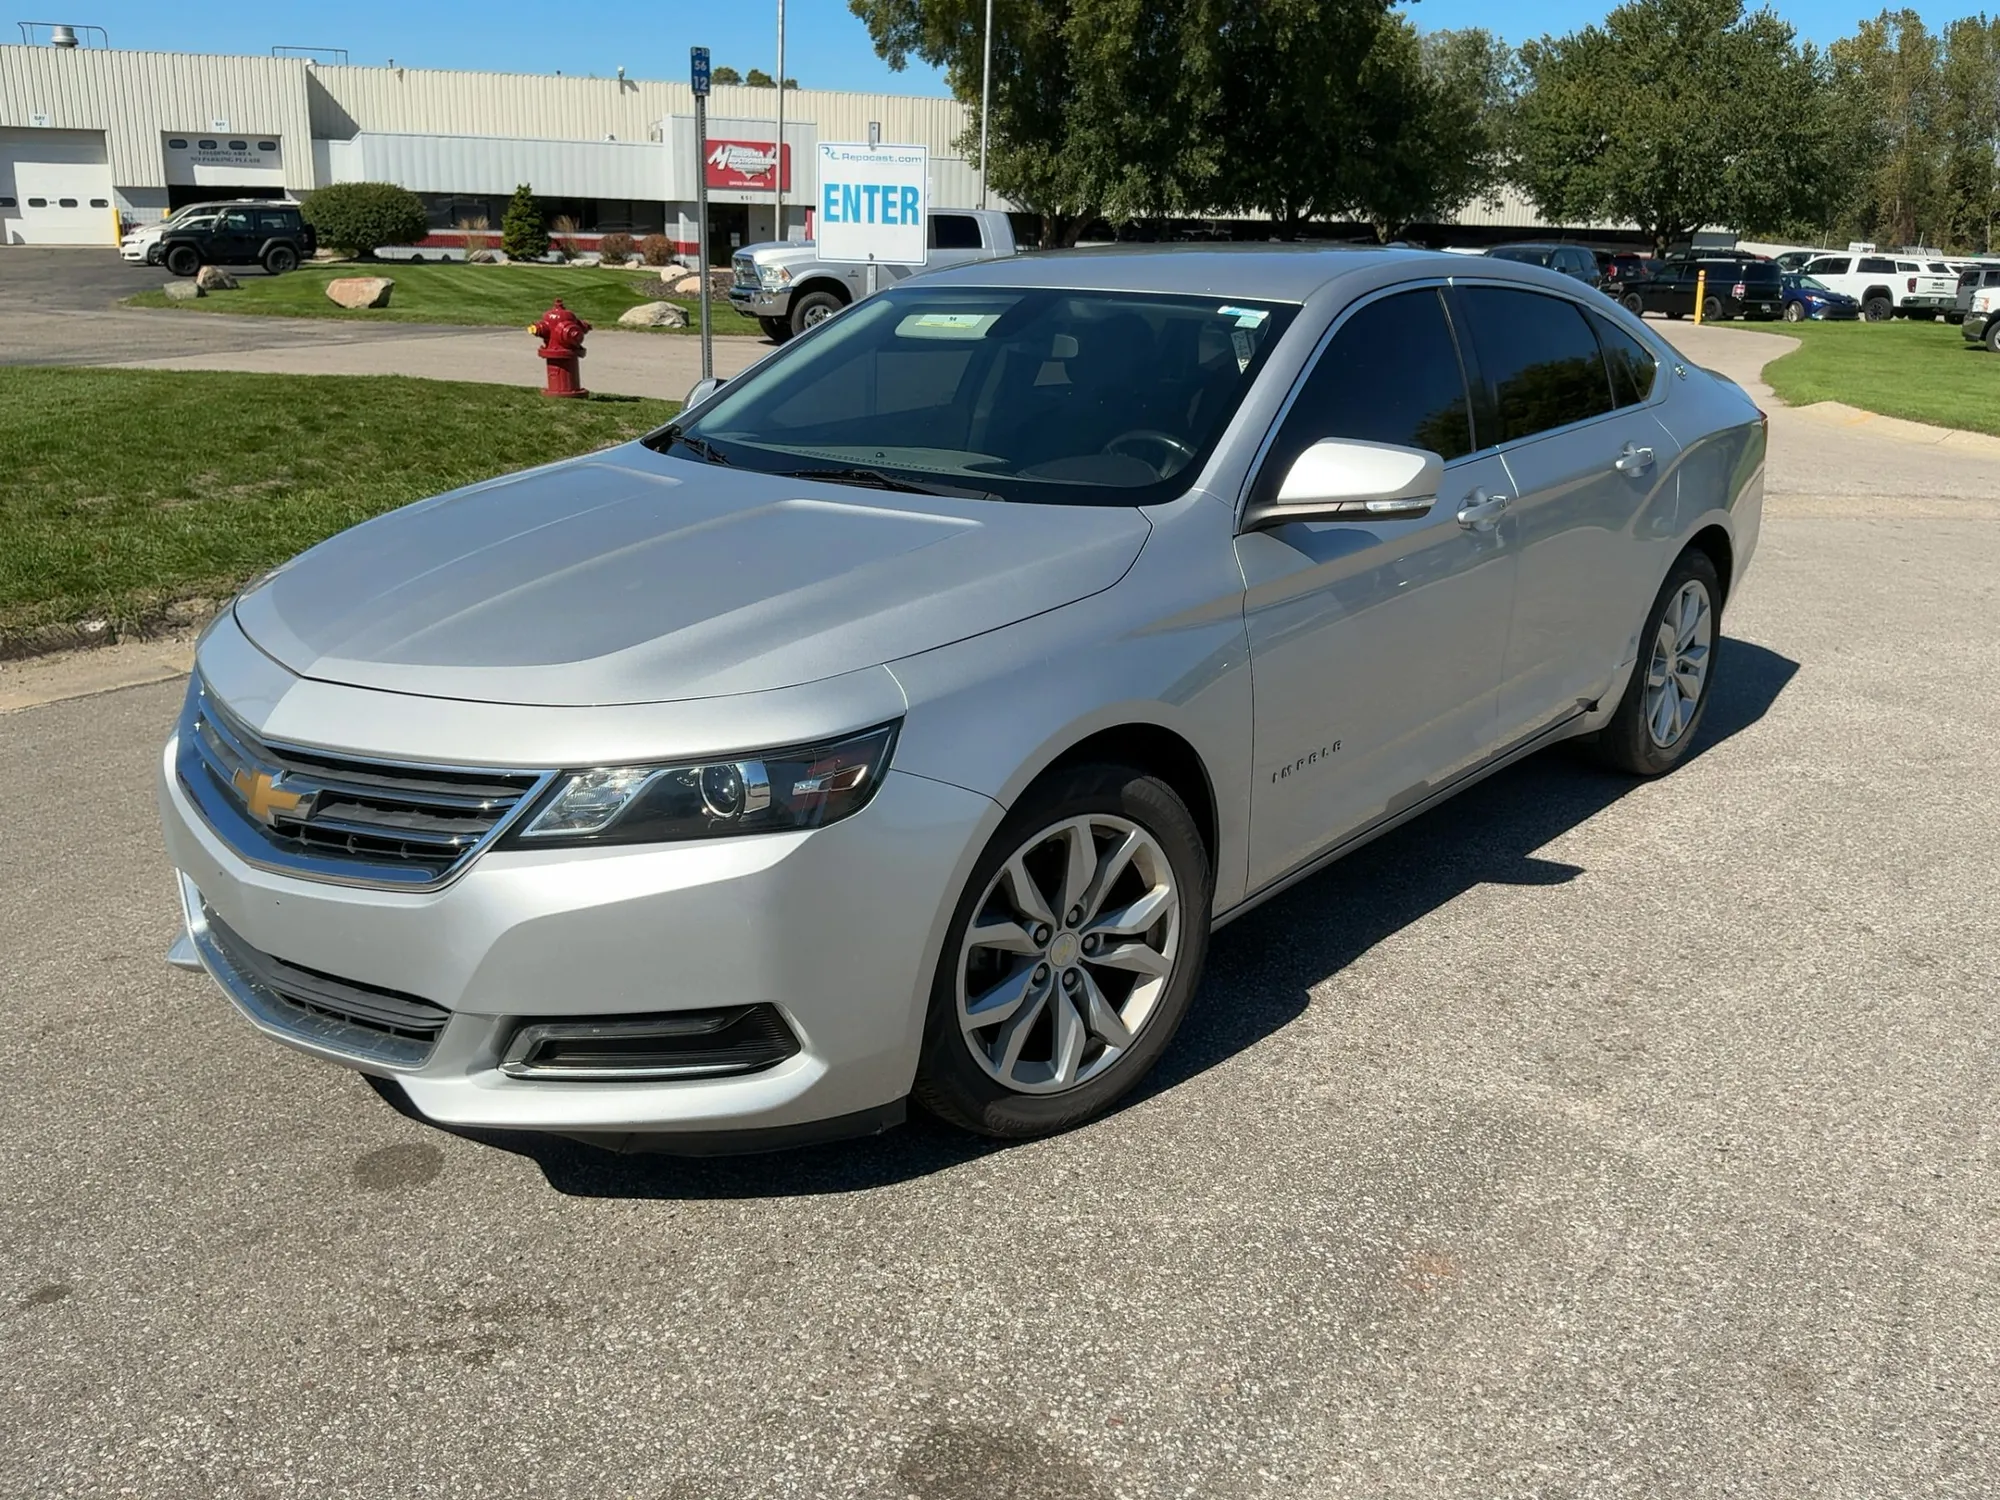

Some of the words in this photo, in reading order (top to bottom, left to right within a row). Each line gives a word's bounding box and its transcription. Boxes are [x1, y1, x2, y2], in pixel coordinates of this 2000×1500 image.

[694, 60, 707, 71] 56
[693, 76, 708, 90] 12
[842, 153, 922, 164] Repocast.com
[824, 183, 920, 226] ENTER
[1272, 739, 1343, 784] IMPALA
